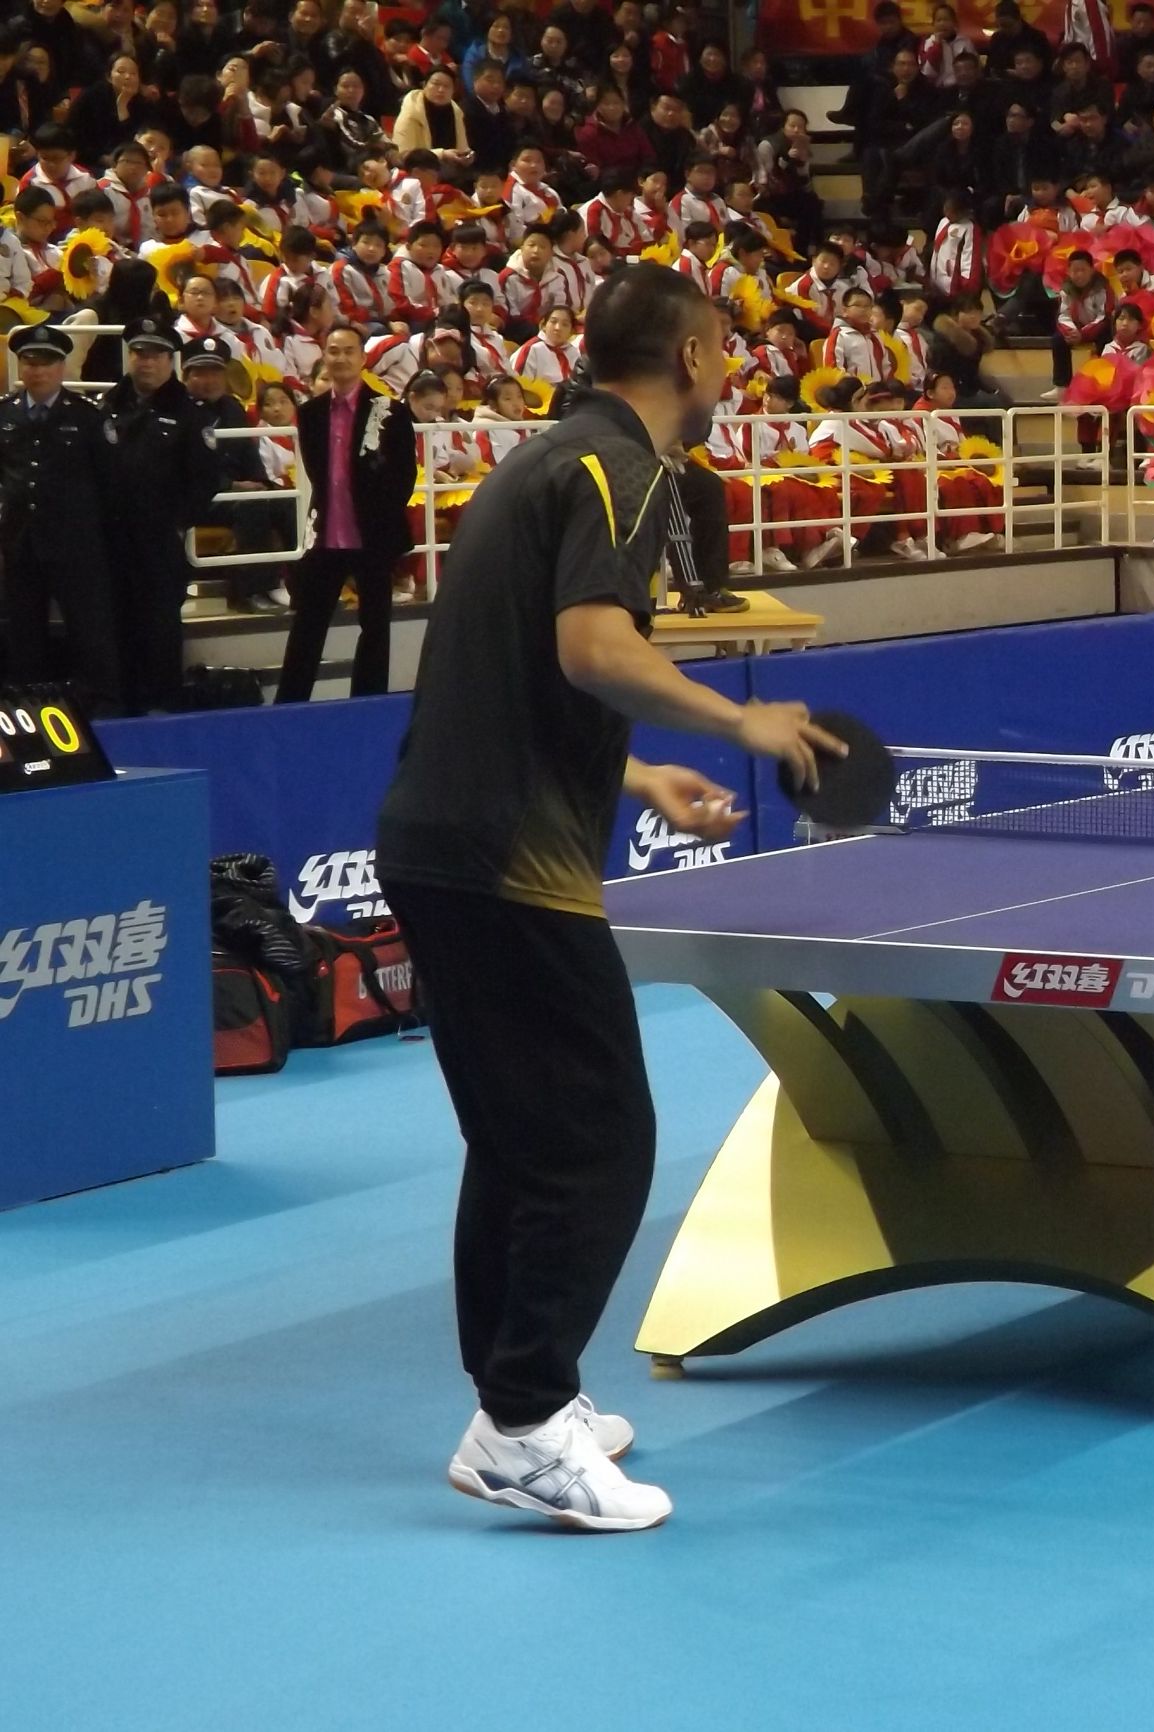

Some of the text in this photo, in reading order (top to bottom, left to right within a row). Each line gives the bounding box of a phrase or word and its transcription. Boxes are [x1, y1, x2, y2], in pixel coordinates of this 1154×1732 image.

[40, 706, 80, 753] 0
[673, 841, 731, 871] DHS
[287, 848, 383, 924] 红双
[0, 899, 169, 1020] 红双喜
[1003, 961, 1111, 999] 红双喜
[63, 972, 163, 1028] DHS
